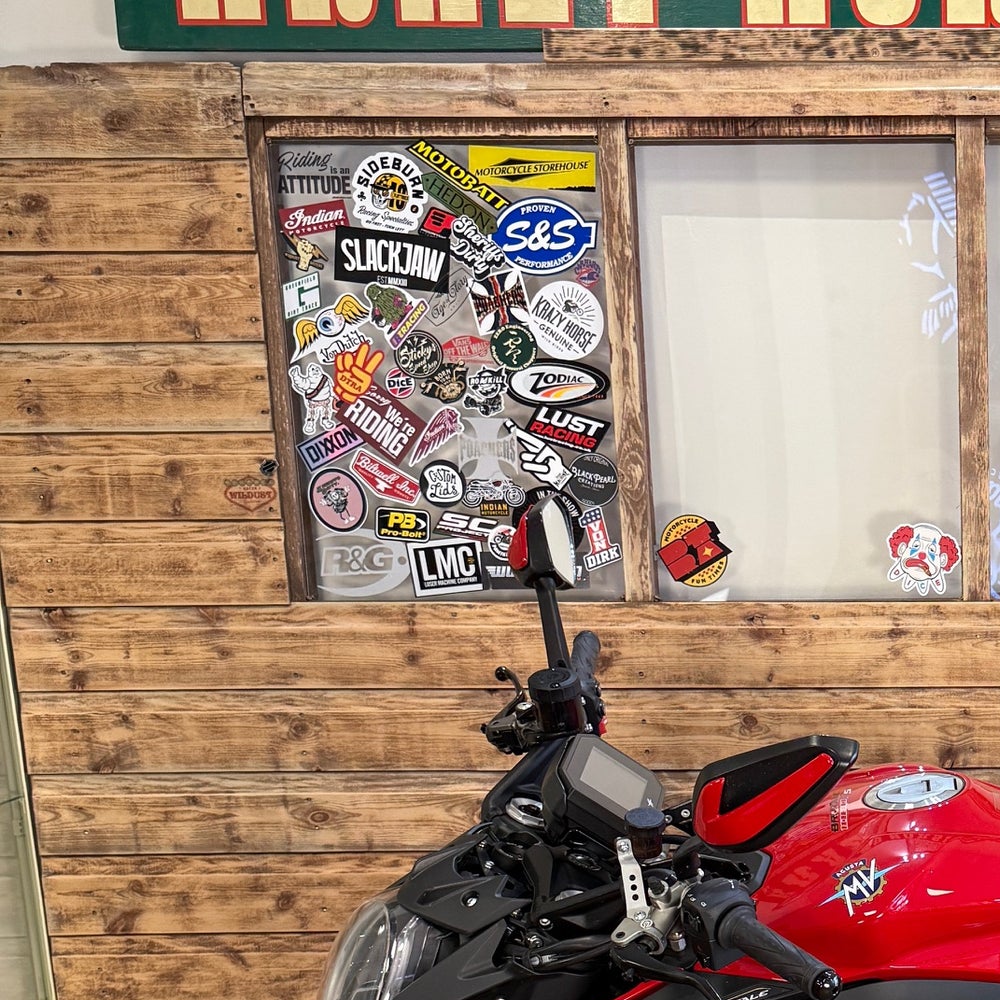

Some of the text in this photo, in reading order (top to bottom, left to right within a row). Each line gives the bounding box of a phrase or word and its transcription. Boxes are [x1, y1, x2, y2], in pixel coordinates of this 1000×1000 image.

[278, 151, 333, 173] Riding
[330, 166, 337, 174] is
[413, 140, 509, 210] MOTOBATT
[475, 160, 590, 177] MOTORCYCLE STOREHOUSE
[278, 175, 351, 194] ATTITUDE
[357, 156, 424, 200] SIDEBURN
[429, 177, 491, 231] HEDON
[520, 204, 557, 216] PROVEN
[284, 208, 346, 230] Indian
[502, 219, 578, 252] S&S
[340, 238, 446, 283] SLACKJAW
[451, 238, 491, 274] Dirty
[513, 252, 574, 270] PERFORMANCE
[531, 295, 567, 328] KRAZY
[564, 319, 597, 354] HORSE
[538, 323, 574, 352] GENUINE
[339, 374, 363, 393] DTRA
[529, 371, 585, 395] ZODIAC
[343, 396, 409, 458] RIDING
[385, 405, 416, 437] We're
[530, 420, 597, 448] RACING
[535, 406, 605, 437] LUST
[305, 427, 359, 464] DIXXON
[355, 455, 399, 485] Biltwell
[428, 468, 457, 485] CUSTOM
[571, 466, 617, 484] BLACK PEARL
[429, 484, 459, 500] Lids
[536, 490, 546, 500] IN
[561, 495, 580, 518] SHOW
[480, 503, 508, 511] INDIAN
[387, 511, 417, 530] PB
[439, 511, 498, 531] SC
[664, 517, 700, 543] MOTORCYCLE
[590, 523, 607, 551] VON
[321, 546, 395, 577] R&G
[418, 545, 475, 582] LMC
[587, 548, 620, 569] DIRK
[438, 578, 458, 587] MACHINE
[457, 576, 477, 586] COMPANY
[691, 578, 703, 586] FUN
[835, 860, 866, 879] AGUSTA
[842, 858, 877, 917] MV
